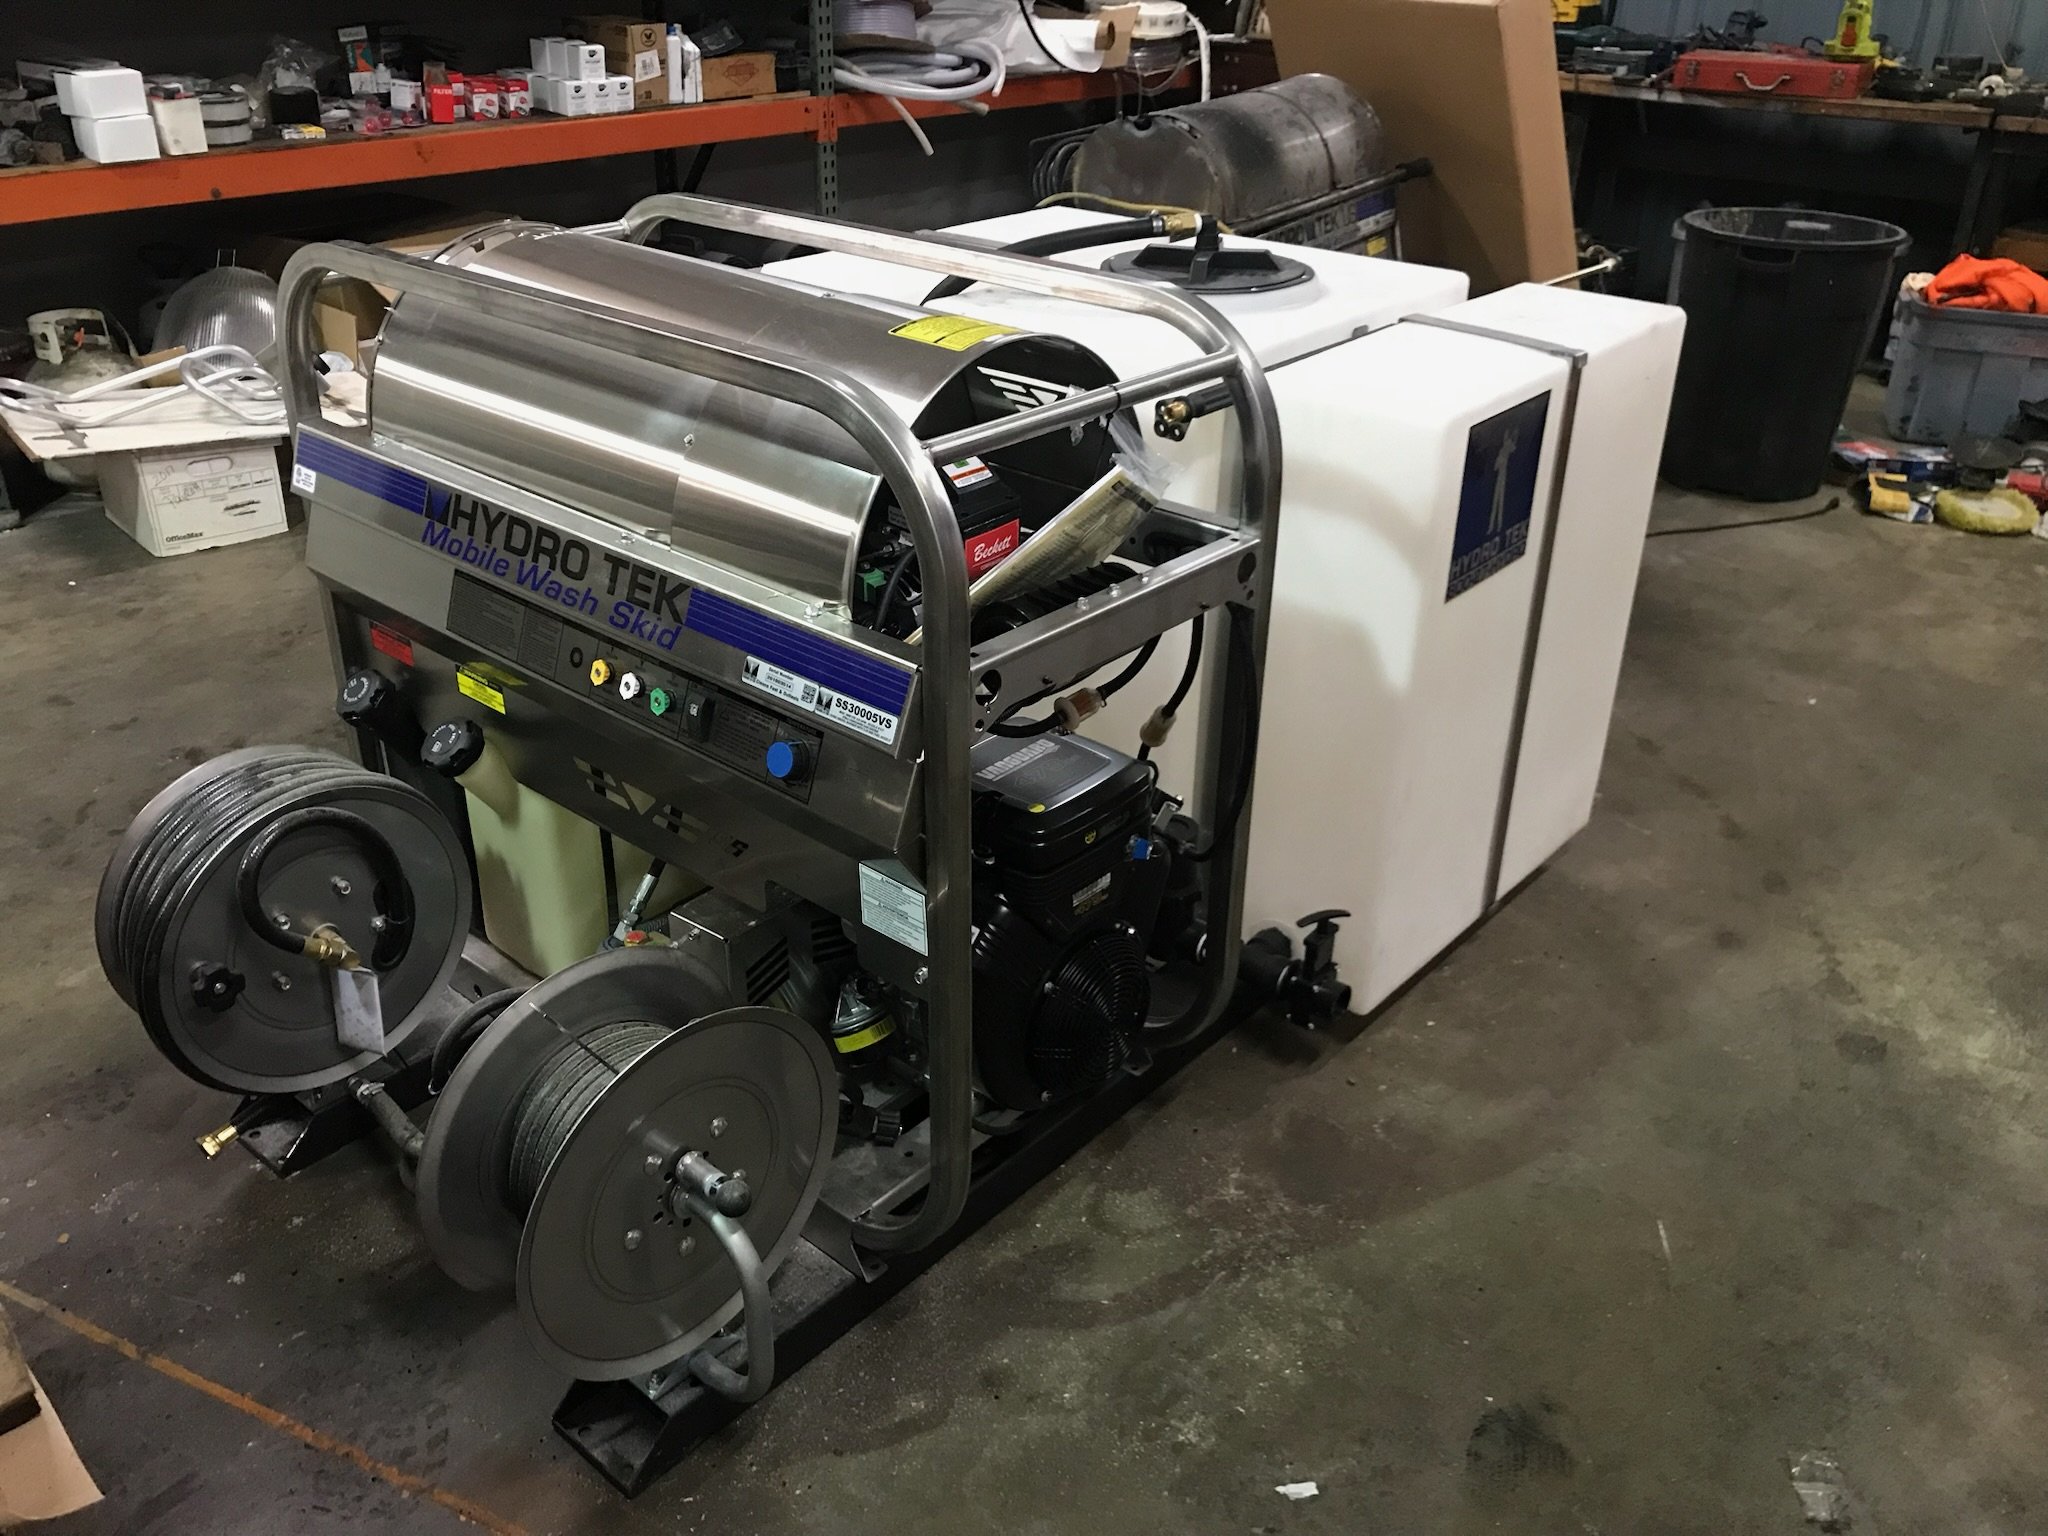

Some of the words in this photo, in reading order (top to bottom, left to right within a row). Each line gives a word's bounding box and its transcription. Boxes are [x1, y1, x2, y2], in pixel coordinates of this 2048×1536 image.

[165, 532, 203, 543] OfficeMax
[973, 535, 1012, 562] Beckett
[1450, 536, 1500, 579] HYDRO
[451, 494, 590, 581] HYDRO
[604, 553, 692, 625] TEK
[421, 521, 510, 578] Mobile
[515, 560, 599, 616] Wash
[608, 601, 683, 650] Skid
[835, 697, 893, 729] SS30005VS
[975, 738, 1056, 780] VANGUARD
